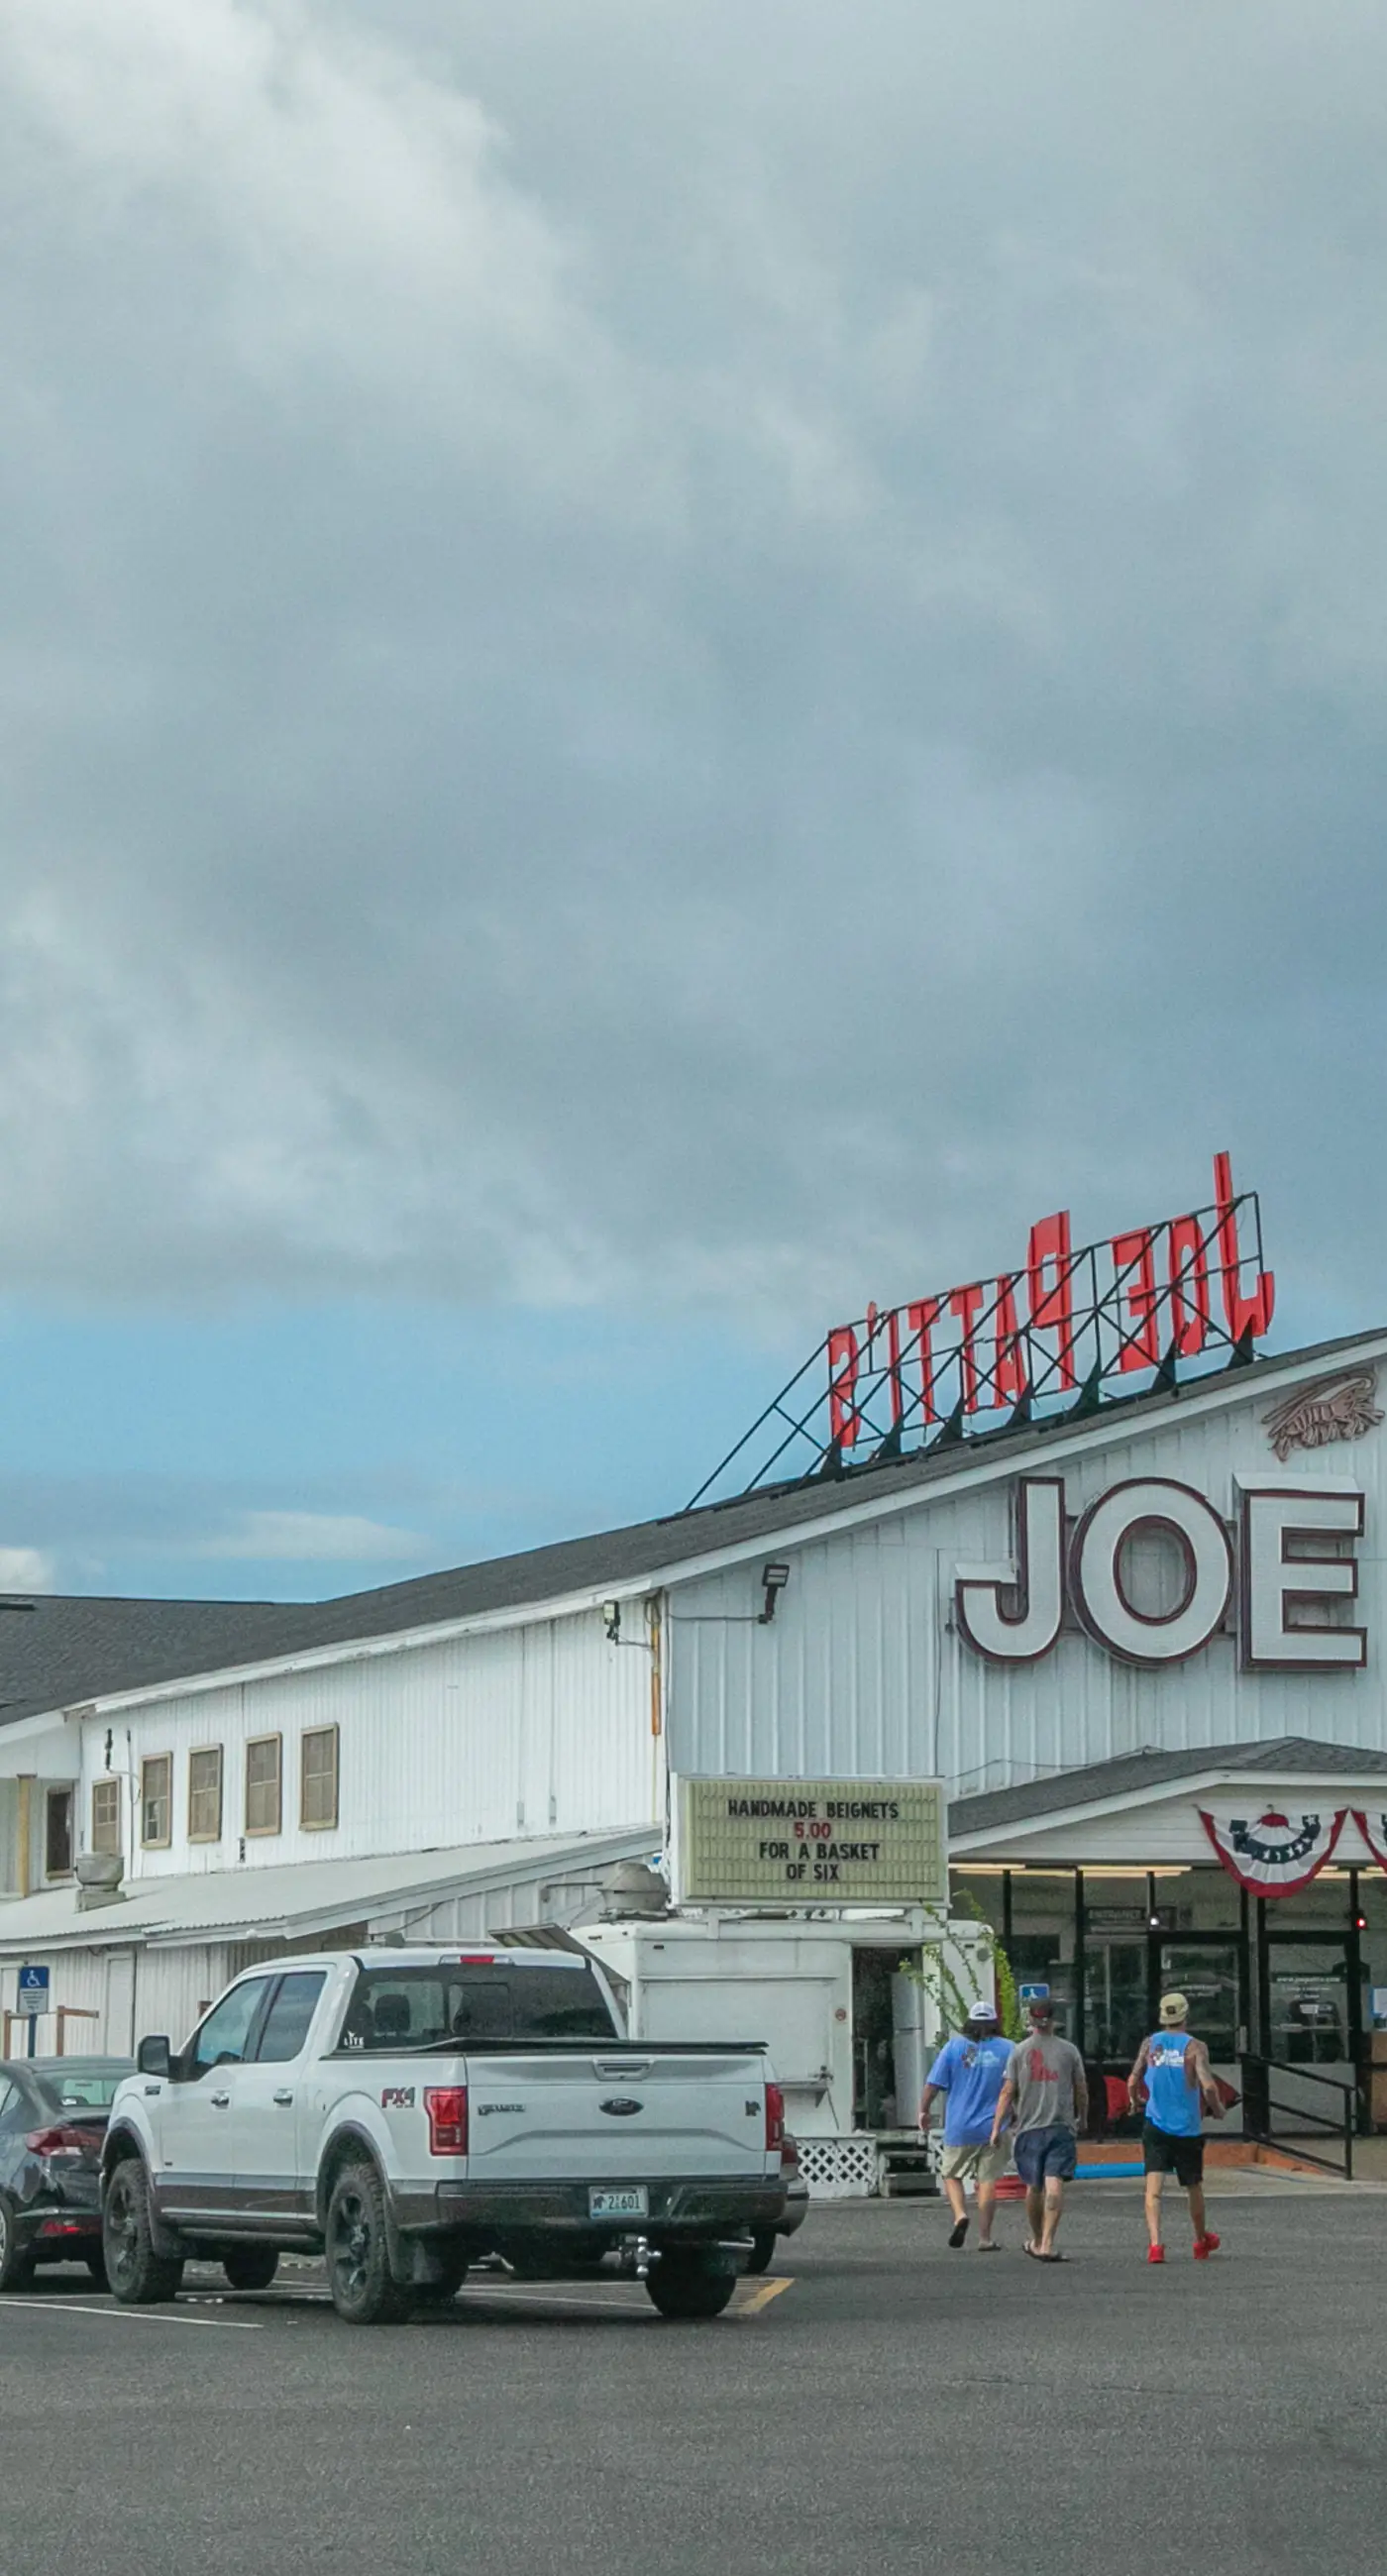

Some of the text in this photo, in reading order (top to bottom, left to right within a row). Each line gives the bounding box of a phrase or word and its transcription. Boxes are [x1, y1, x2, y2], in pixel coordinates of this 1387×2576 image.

[955, 1476, 1367, 1668] JOE
[728, 1799, 899, 1819] HANDMADE BEIGNETS
[794, 1822, 832, 1839] 5.00
[759, 1842, 880, 1861] FOR A BASKET
[786, 1864, 840, 1880] OF SIX
[381, 2087, 415, 2108] FX4
